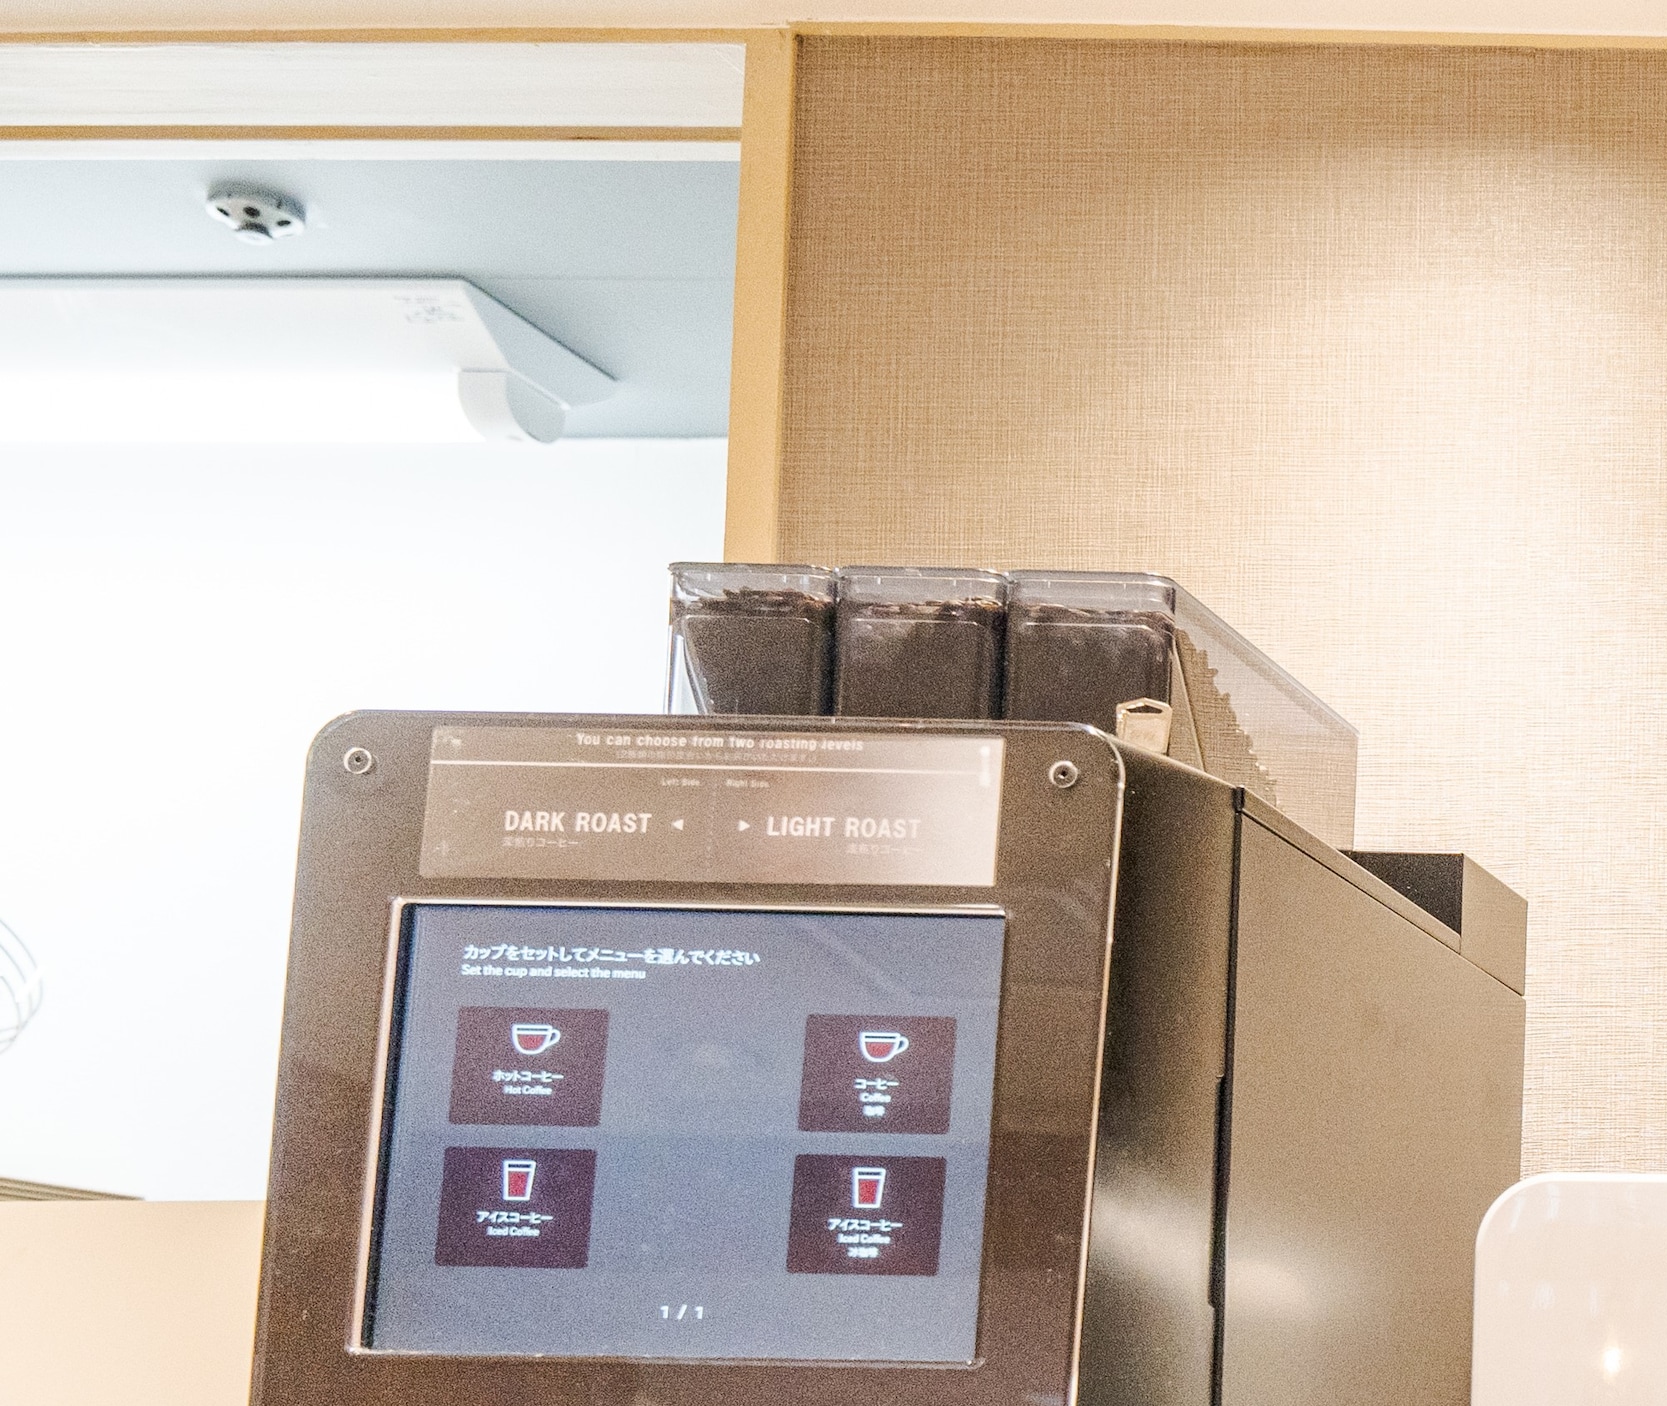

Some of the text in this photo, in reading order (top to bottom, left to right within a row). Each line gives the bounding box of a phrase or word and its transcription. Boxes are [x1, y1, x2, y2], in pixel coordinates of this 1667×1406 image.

[576, 732, 864, 751] You can choose from two roasting levels
[504, 810, 653, 834] DARK ROAST
[766, 816, 922, 839] LIGHT ROAST
[463, 943, 761, 965] カップをセットしてメニューを選んでください
[461, 963, 646, 979] Set the cup and select the menu
[492, 1069, 564, 1083] ホットコーヒー
[503, 1085, 553, 1095] Hot Coffee
[853, 1078, 899, 1090] コーヒー
[475, 1210, 554, 1224] アイスコーヒー
[486, 1226, 540, 1237] Iced Coffee
[827, 1218, 904, 1232] アイスコーヒー
[660, 1304, 669, 1319] 1
[693, 1305, 703, 1320] 1
